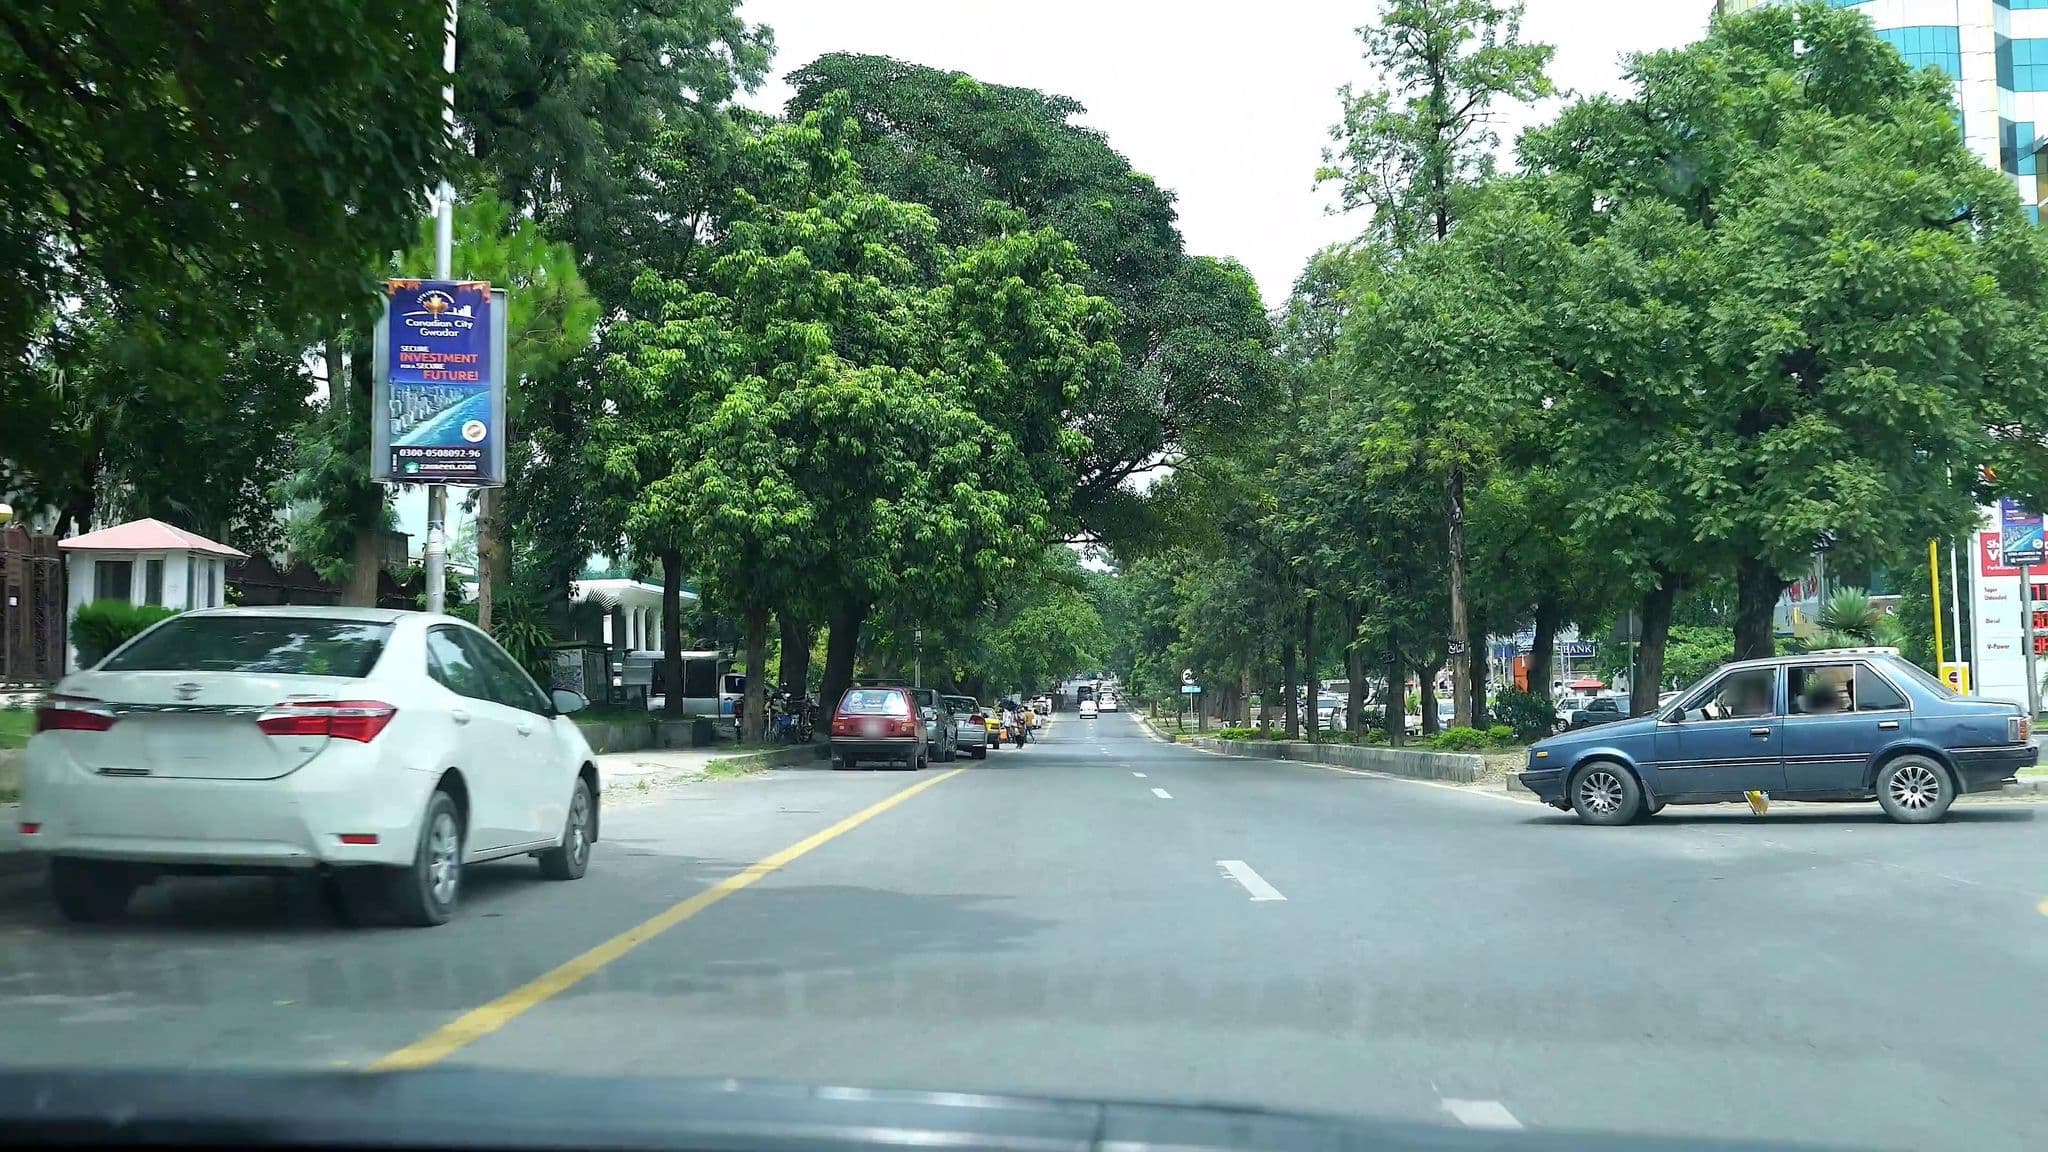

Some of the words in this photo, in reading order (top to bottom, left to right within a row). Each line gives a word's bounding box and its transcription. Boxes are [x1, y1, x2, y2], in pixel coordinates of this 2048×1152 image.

[405, 319, 452, 328] Canadian
[454, 320, 474, 329] City
[419, 327, 460, 337] Gwadar
[400, 352, 478, 363] INVESTMENT
[415, 362, 445, 370] SECURE
[423, 370, 479, 381] FUTURE!
[399, 448, 481, 458] 0300-0508092-96
[1562, 645, 1592, 654] BANK
